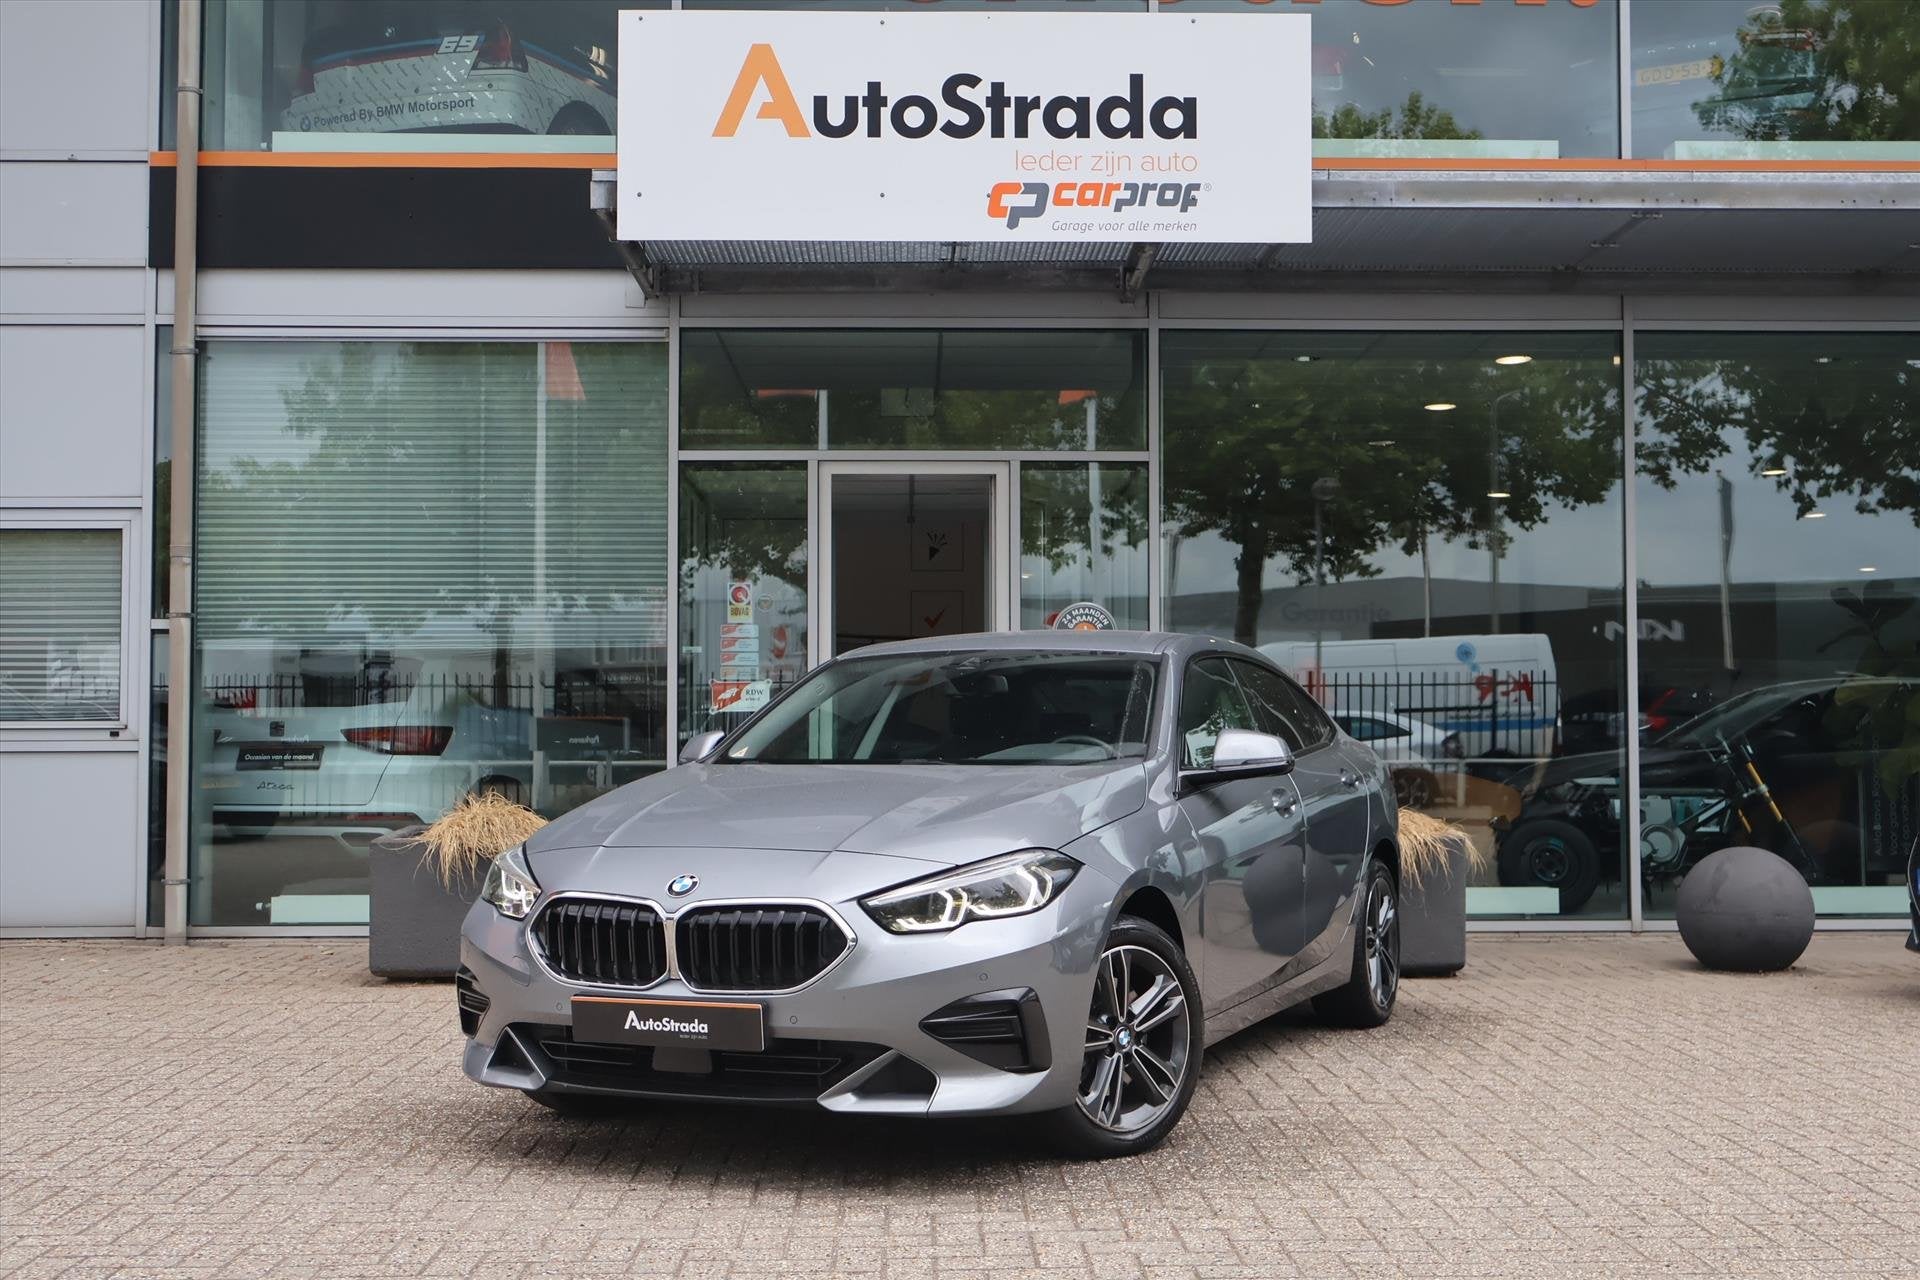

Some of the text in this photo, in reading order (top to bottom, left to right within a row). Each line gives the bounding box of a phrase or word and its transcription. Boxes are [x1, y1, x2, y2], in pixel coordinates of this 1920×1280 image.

[438, 35, 480, 54] 69
[712, 43, 1198, 140] AutoStrada
[314, 97, 475, 128] Powered By BMW Motorsport
[1013, 150, 1198, 177] Ieder zijn auto
[1051, 220, 1198, 234] Garage voor alle merken
[1062, 608, 1110, 626] 24 MAANDEN
[1067, 614, 1105, 629] GARANTIE
[745, 688, 764, 696] RDW
[624, 1010, 709, 1034] AutoStrada
